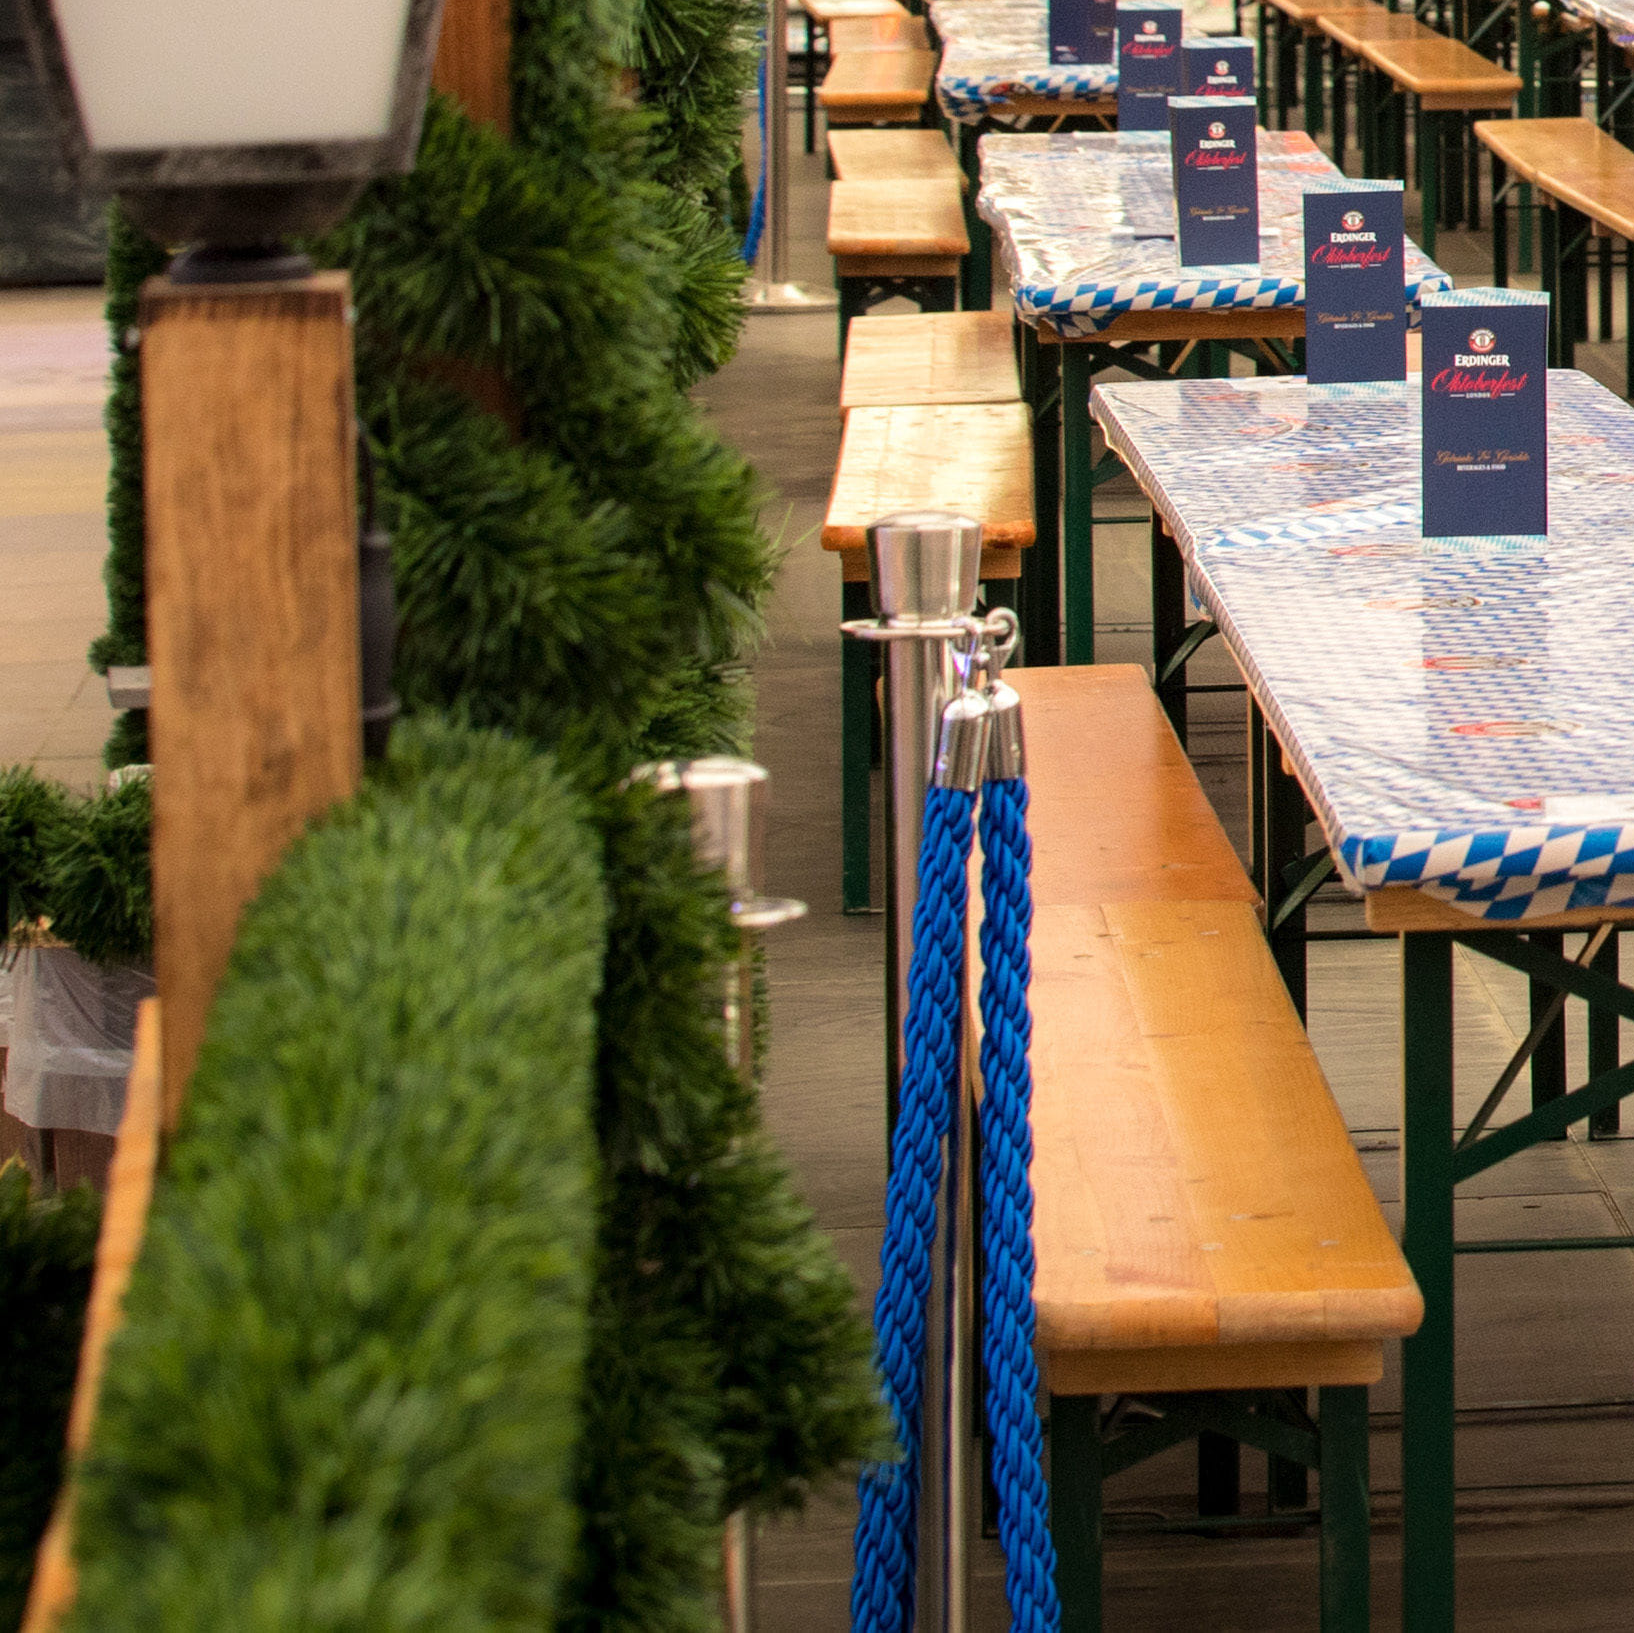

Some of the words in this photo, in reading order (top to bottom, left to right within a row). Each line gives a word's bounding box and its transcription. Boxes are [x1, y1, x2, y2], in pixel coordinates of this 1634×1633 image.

[1330, 232, 1377, 243] ERDINGER
[1454, 354, 1511, 367] ERDINGER
[1431, 367, 1529, 399] Oktoberfest
